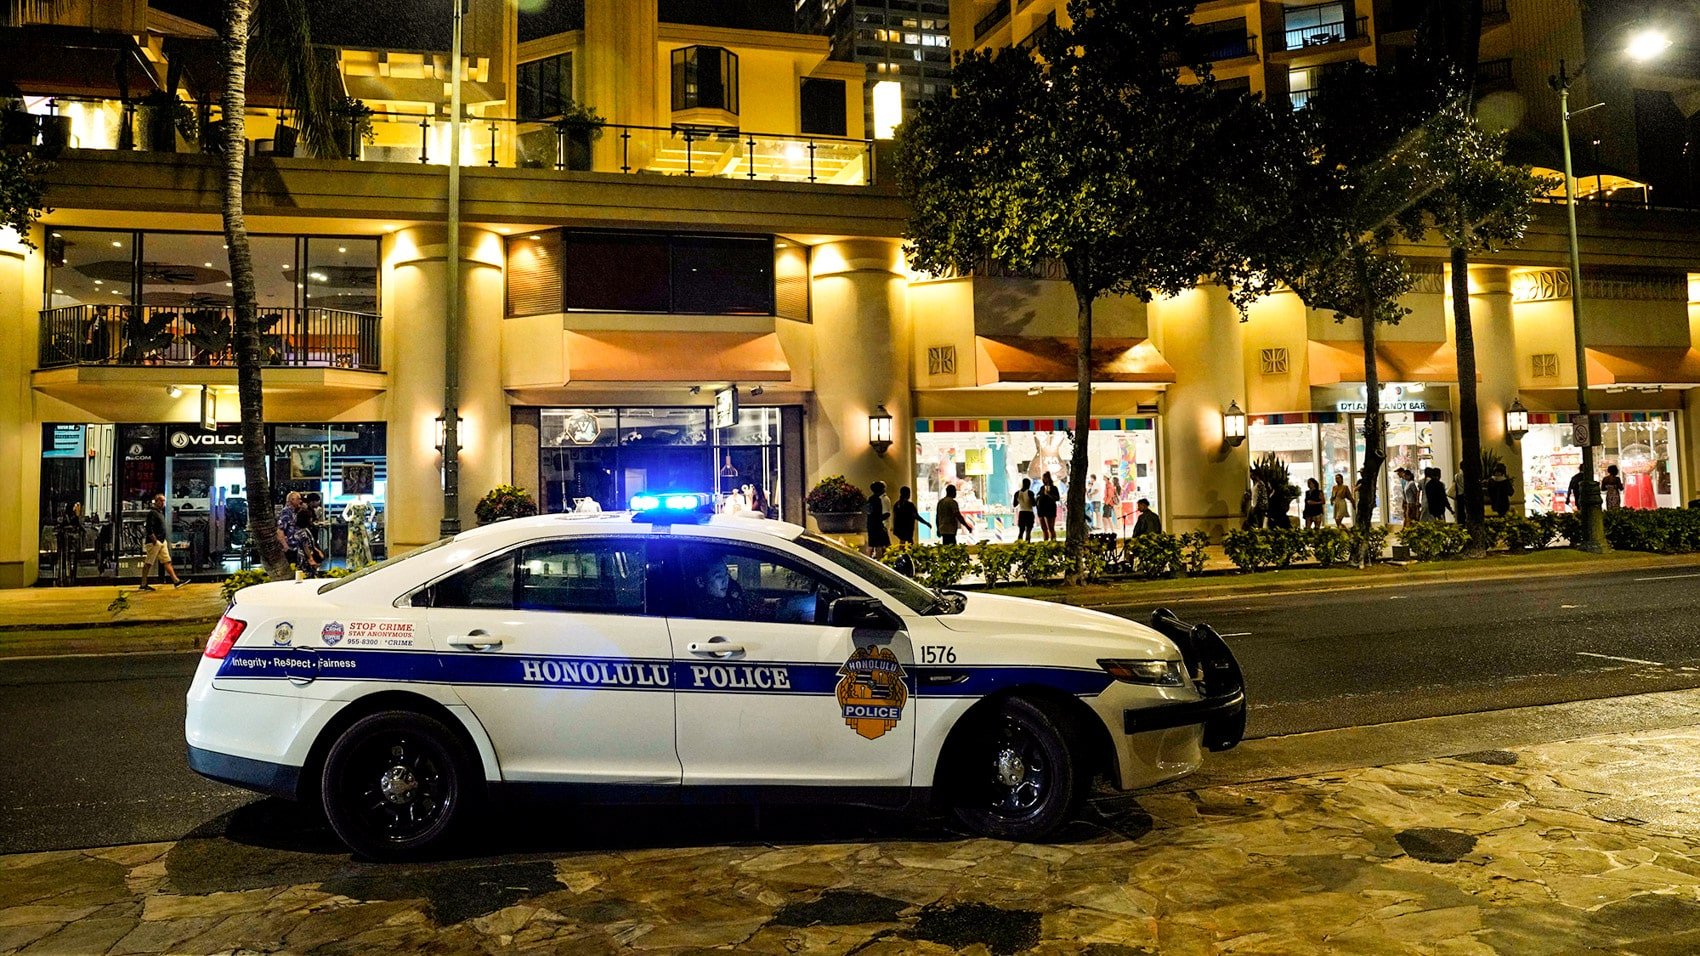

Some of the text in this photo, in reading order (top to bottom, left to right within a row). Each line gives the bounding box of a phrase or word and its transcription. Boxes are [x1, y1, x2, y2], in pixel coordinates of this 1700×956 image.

[1409, 402, 1427, 410] BAR
[188, 434, 266, 445] VOLC
[349, 622, 415, 632] STOP CRIME.
[920, 645, 957, 664] 1576
[232, 657, 356, 668] Integrity Respect Fairness
[848, 659, 898, 672] HONOLULU
[519, 659, 791, 690] HONOLULU POLICE
[845, 706, 898, 718] POLICE
